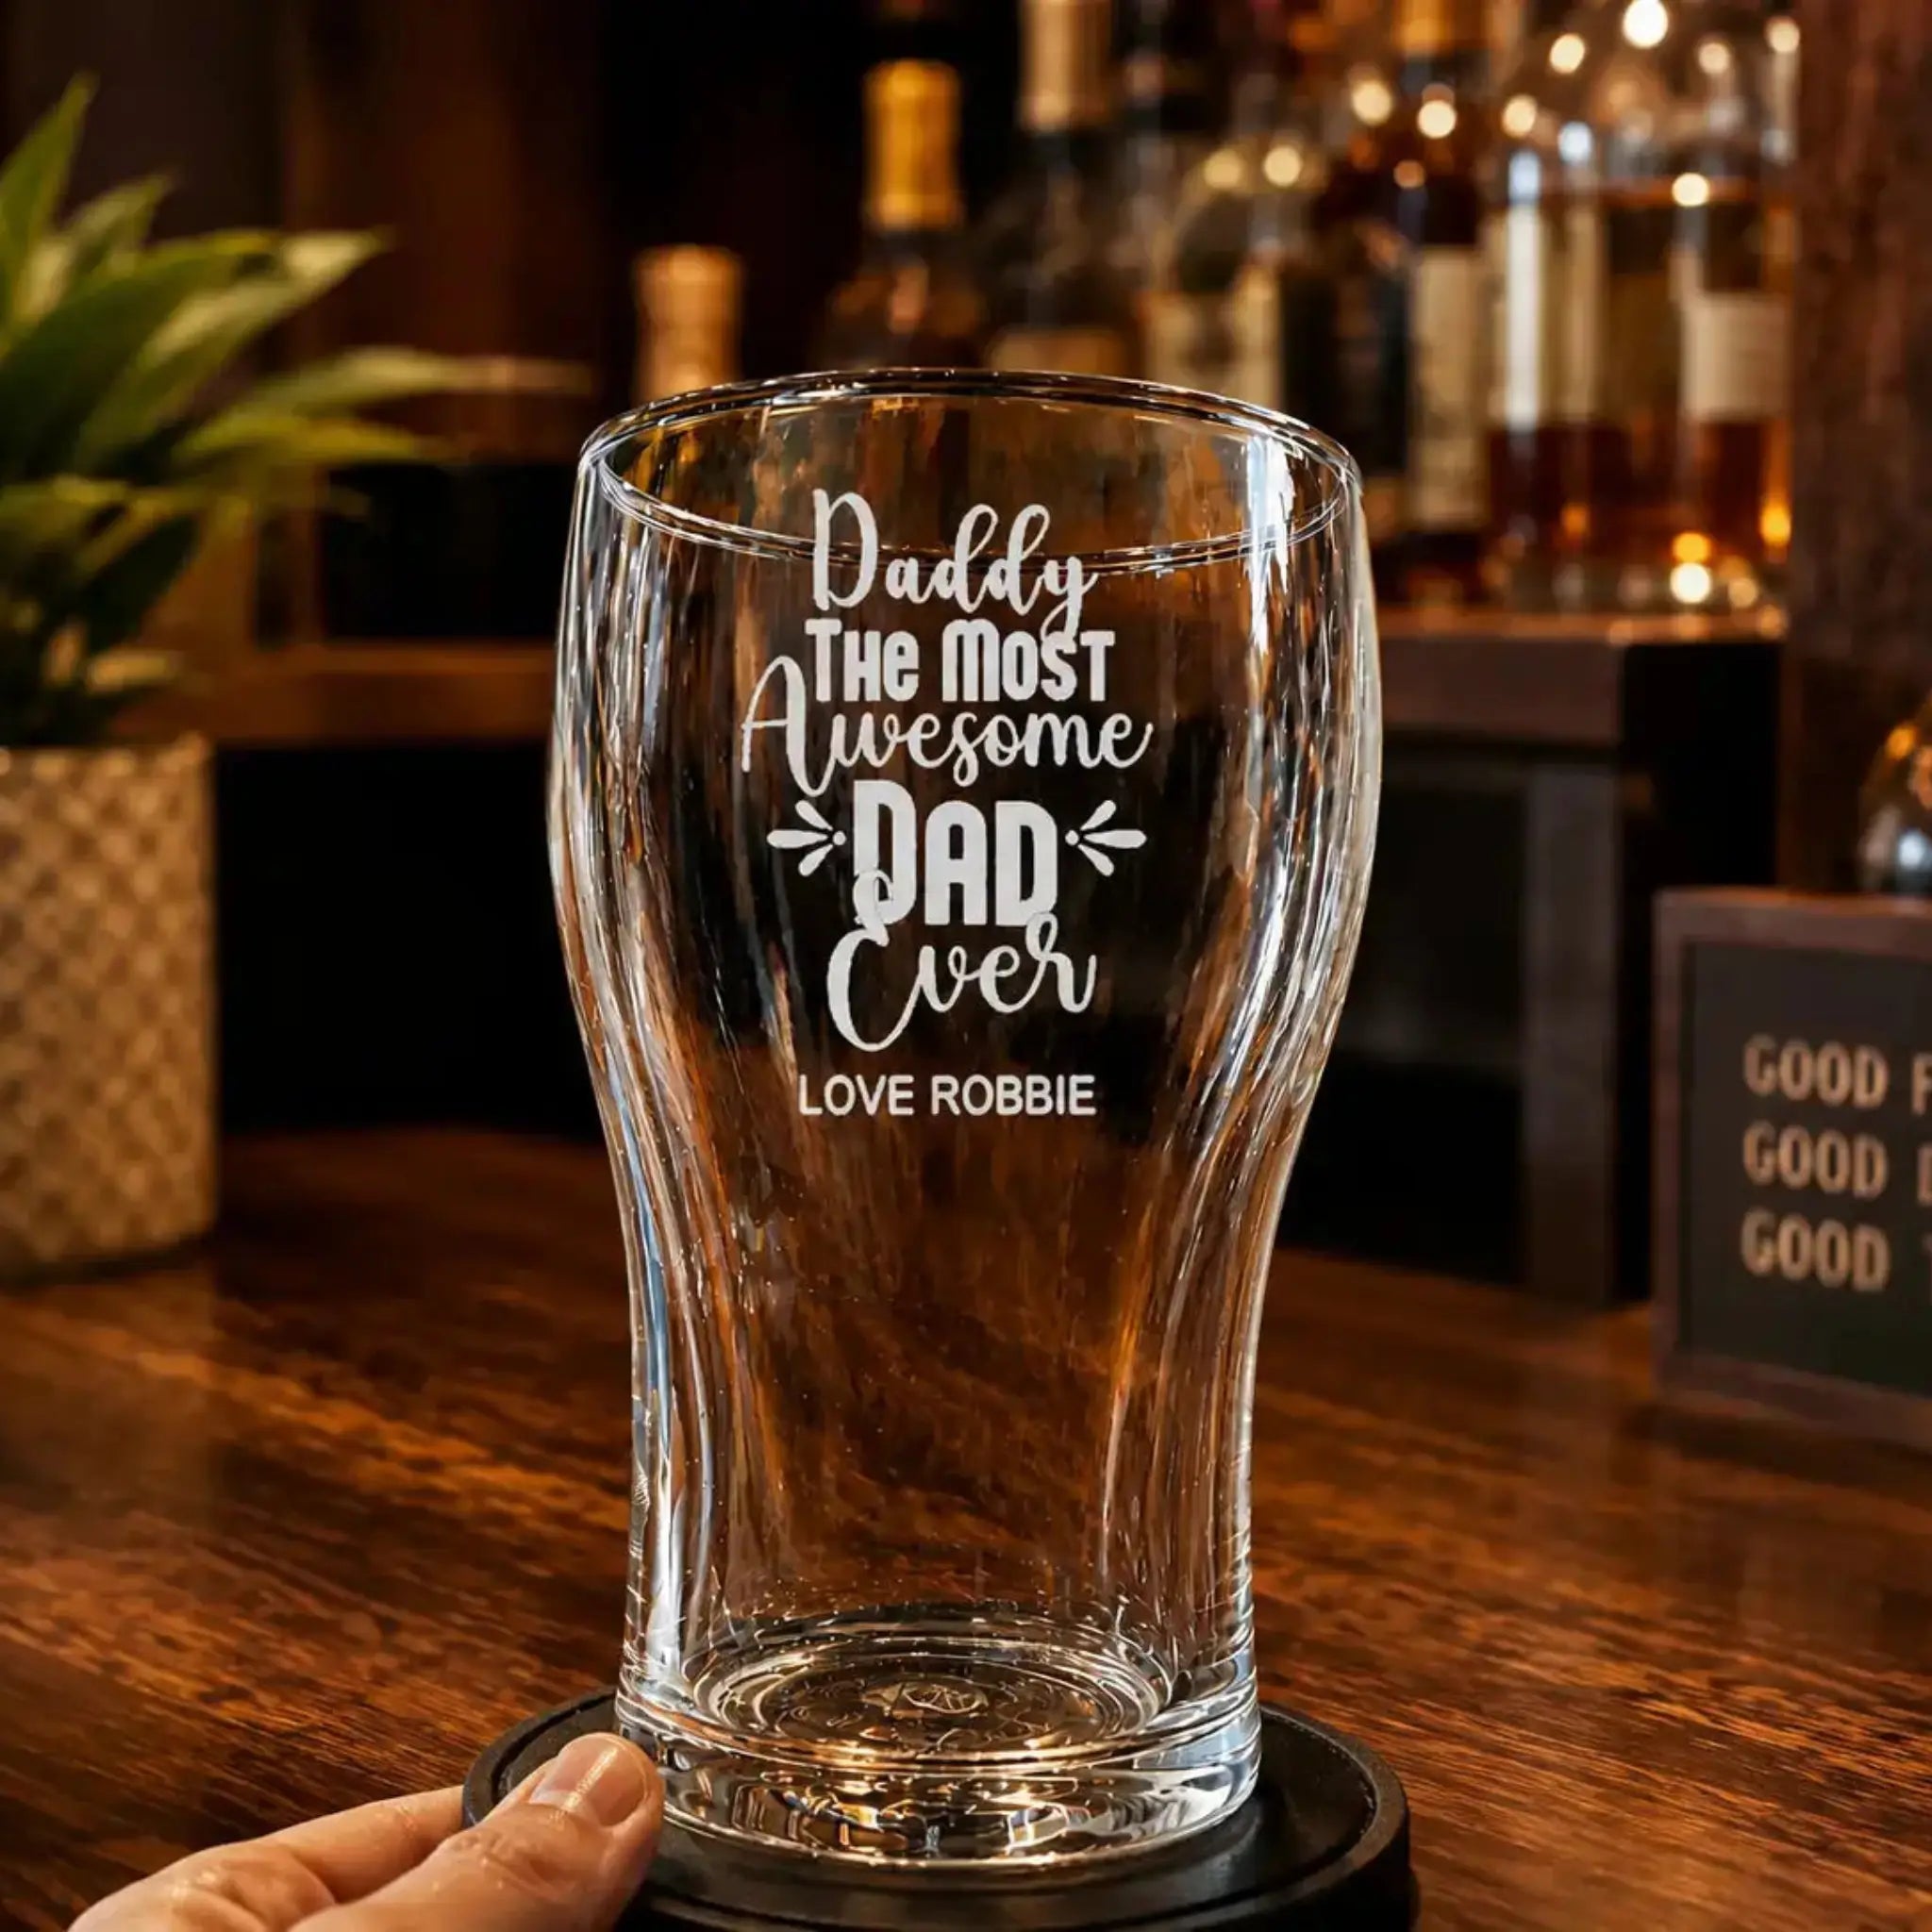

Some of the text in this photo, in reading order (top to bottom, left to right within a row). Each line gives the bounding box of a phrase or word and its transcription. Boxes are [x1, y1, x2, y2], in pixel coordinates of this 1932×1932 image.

[812, 489, 1098, 644] Daddy
[741, 656, 1154, 796] Awesome
[853, 779, 1058, 925] DAD
[826, 870, 1097, 1052] Ever
[798, 1074, 1097, 1116] LOVE ROBBIE
[1743, 1034, 1889, 1108] GOOD
[1742, 1121, 1889, 1198] GOOD
[1740, 1208, 1890, 1291] GOOD
